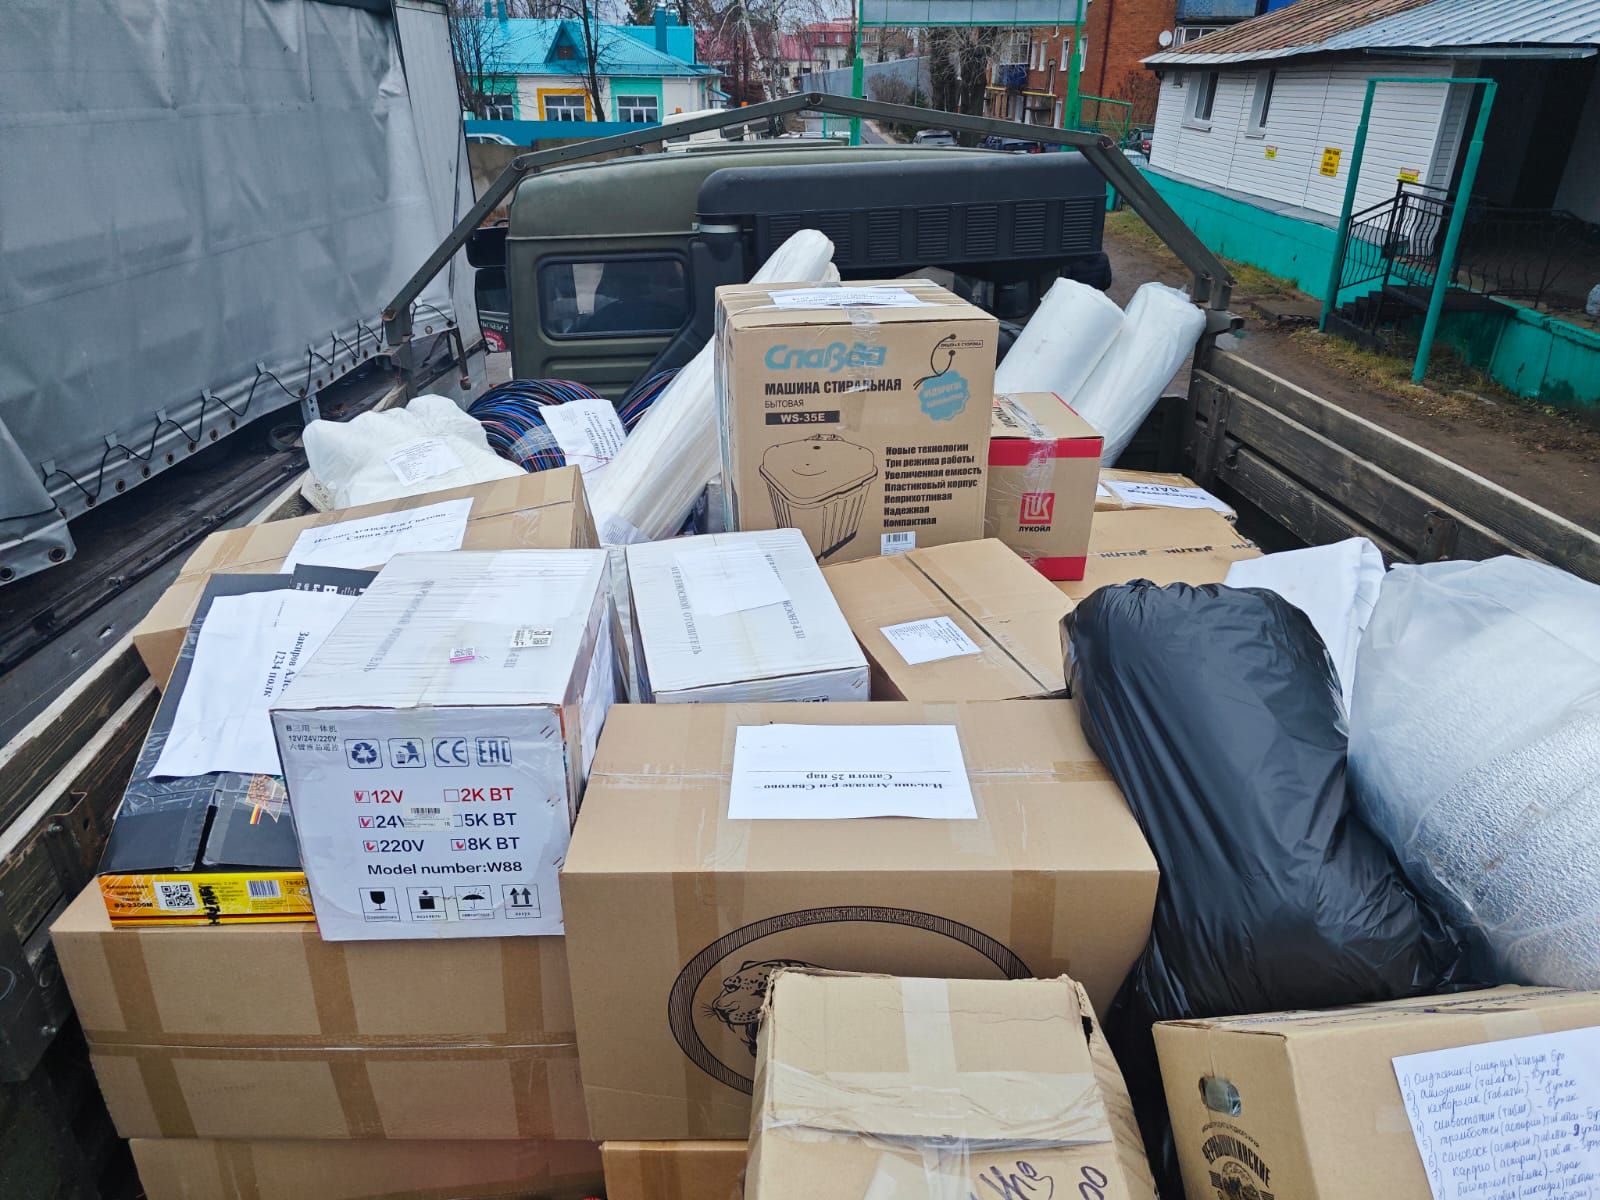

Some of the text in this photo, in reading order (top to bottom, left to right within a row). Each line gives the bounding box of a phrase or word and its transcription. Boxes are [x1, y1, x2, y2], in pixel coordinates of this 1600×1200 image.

[765, 382, 820, 396] МАШИНА
[765, 399, 804, 408] БЫТОВАЯ
[781, 413, 825, 423] WS-35E
[886, 444, 969, 456] Новые технологии
[886, 455, 975, 468] Три режима работы
[885, 467, 982, 480] Увеличенная емкость
[885, 479, 978, 492] Пластиковый корпус
[884, 493, 952, 504] Неприхотливая
[884, 506, 930, 516] Надежная
[884, 517, 937, 528] Компактная
[1018, 525, 1051, 533] ЛУКОЙЛ
[1100, 549, 1149, 559] HUTER
[1166, 545, 1213, 554] HUTER
[271, 651, 287, 670] 1234
[371, 790, 404, 803] 12V
[380, 840, 424, 852] 220V
[367, 861, 522, 875] Model number:W88
